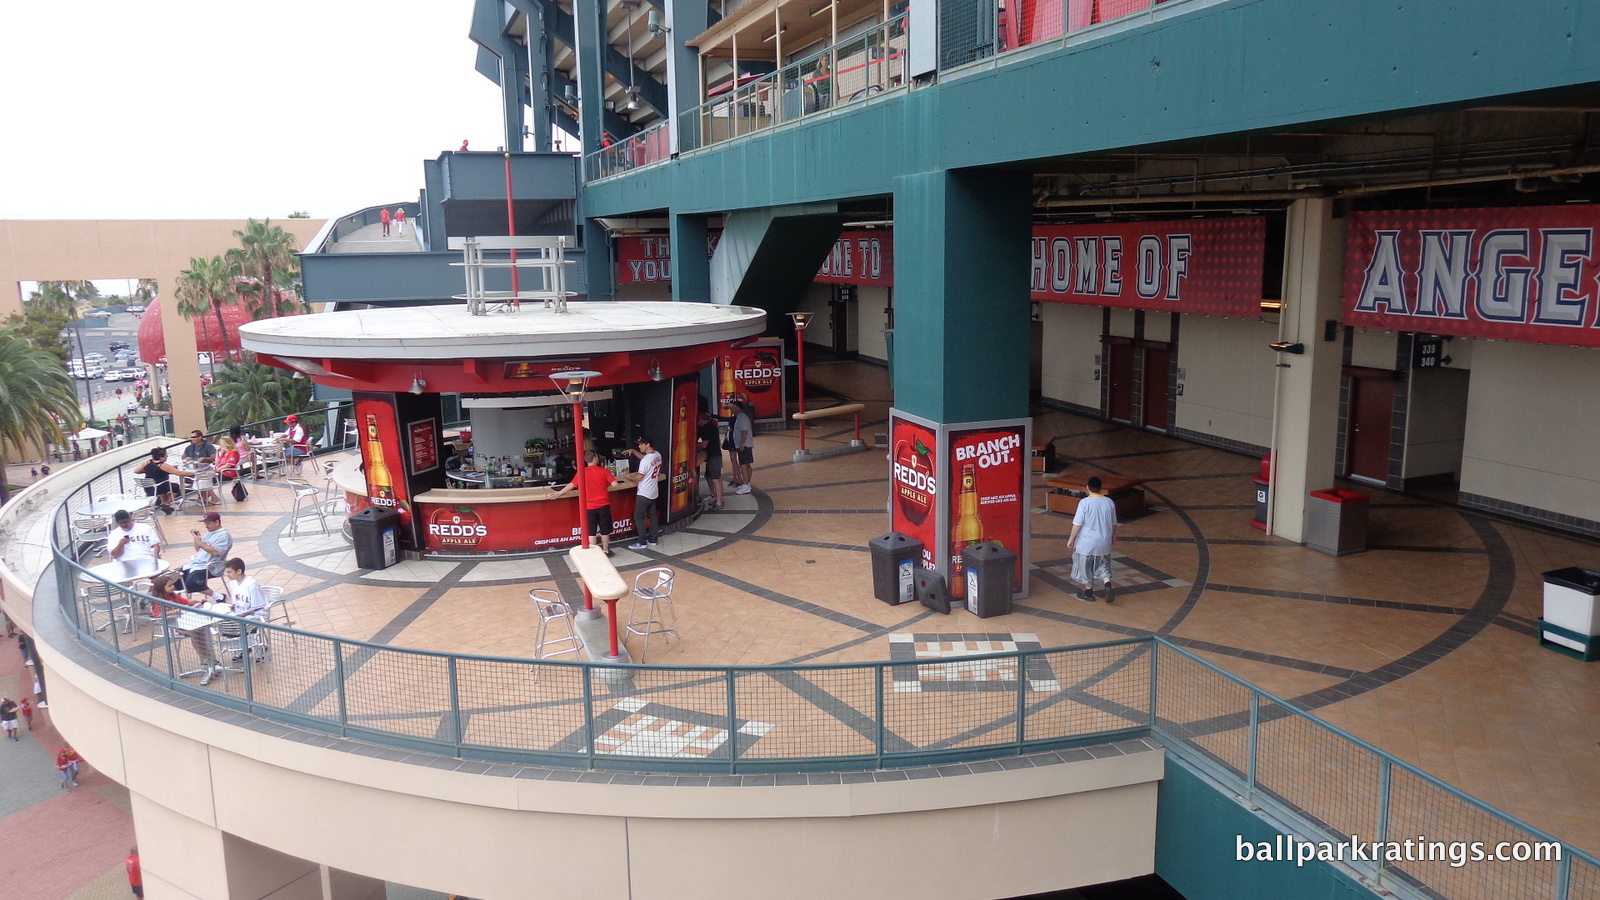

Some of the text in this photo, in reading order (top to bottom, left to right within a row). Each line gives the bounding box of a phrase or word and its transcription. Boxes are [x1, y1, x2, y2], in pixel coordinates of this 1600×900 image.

[858, 238, 882, 279] TO
[1031, 234, 1192, 300] HOME OF
[628, 259, 673, 282] YOU
[1353, 227, 1600, 328] ANGE
[1421, 356, 1435, 367] 340
[734, 365, 782, 379] REDD'S
[955, 434, 1020, 461] BRANCH
[978, 449, 1015, 469] OUT.
[894, 462, 936, 495] REDD'S
[901, 486, 927, 505] APPLE ALE
[429, 522, 487, 536] REDD'S
[612, 519, 632, 529] OUT.
[921, 549, 931, 560] OU
